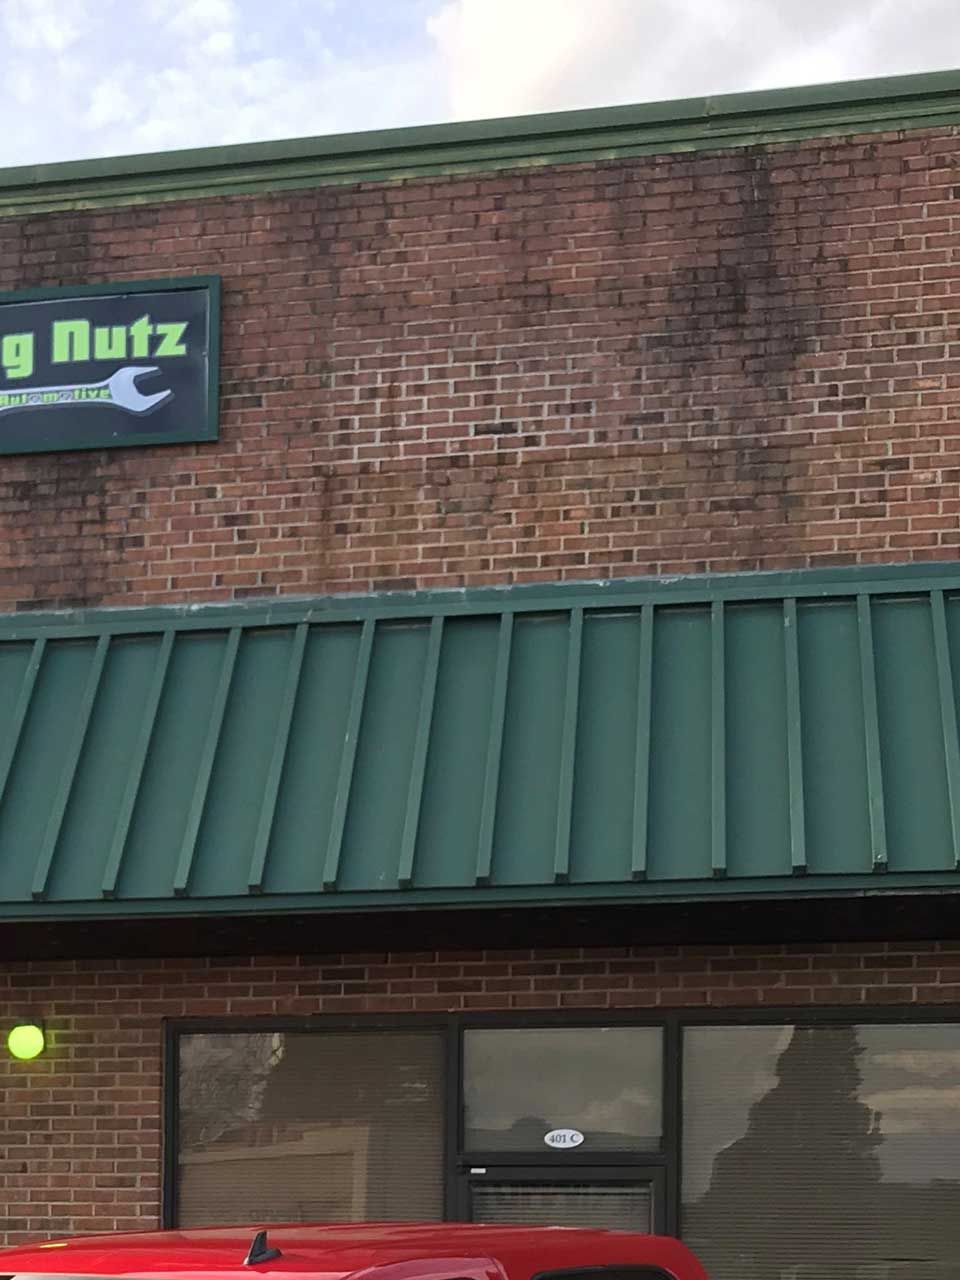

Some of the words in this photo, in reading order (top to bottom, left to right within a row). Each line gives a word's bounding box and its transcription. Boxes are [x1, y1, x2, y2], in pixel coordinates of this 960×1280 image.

[51, 313, 189, 364] Nutz
[549, 1134, 567, 1143] 401
[570, 1133, 579, 1143] C
